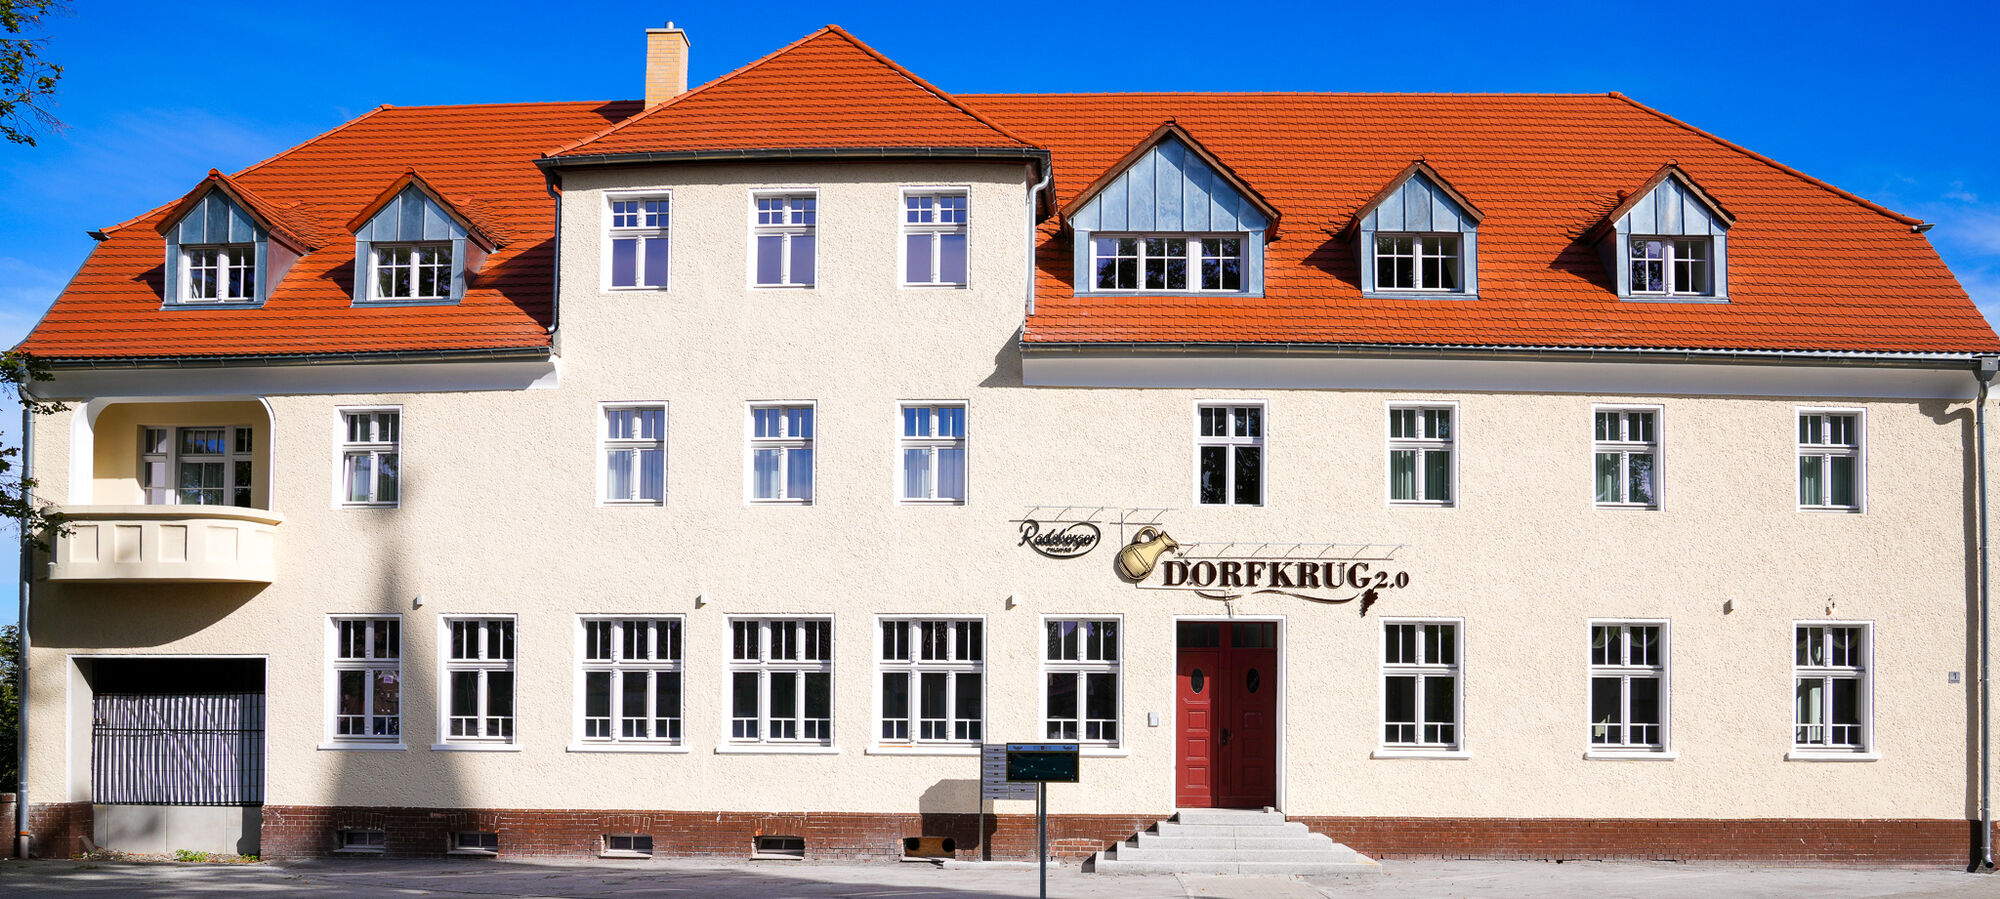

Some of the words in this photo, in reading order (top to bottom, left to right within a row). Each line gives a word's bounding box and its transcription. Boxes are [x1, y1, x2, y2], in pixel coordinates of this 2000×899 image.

[1017, 519, 1098, 553] Radeberger
[1161, 560, 1372, 589] DORFKRUG
[1373, 570, 1409, 589] 2.0
